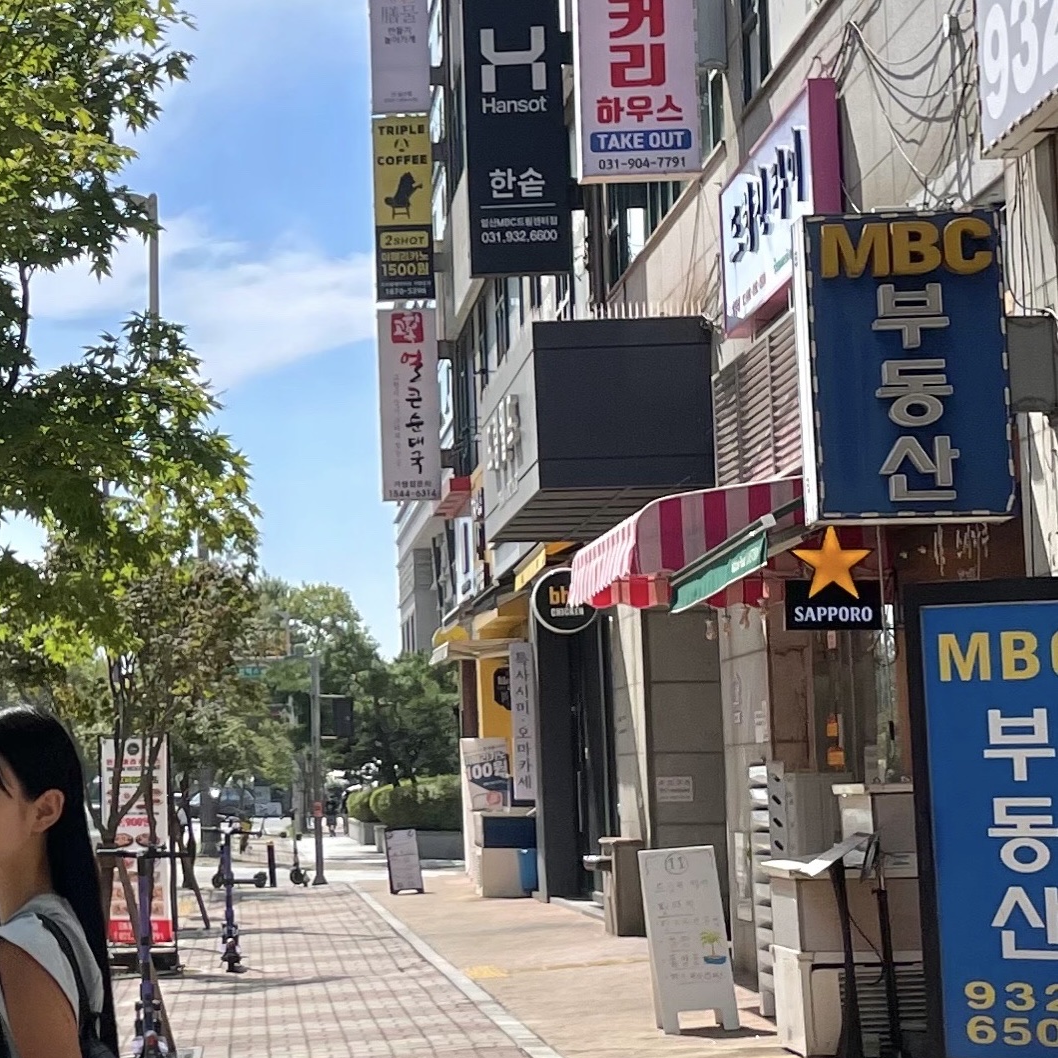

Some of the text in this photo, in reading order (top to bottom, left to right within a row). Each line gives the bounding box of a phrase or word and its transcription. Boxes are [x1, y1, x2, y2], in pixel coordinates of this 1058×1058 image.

[607, 0, 667, 88] 커리
[482, 95, 547, 114] Hansot
[596, 94, 684, 124] 하우스
[378, 124, 425, 136] TRIPLE
[597, 130, 685, 150] TAKE OUT
[377, 154, 428, 166] COFFEE
[598, 156, 686, 170] 031-904-7791
[489, 166, 546, 199] 한솥
[820, 217, 994, 279] MBC
[380, 262, 430, 277] 1500원
[871, 283, 961, 502] 부동산
[794, 605, 873, 623] SAPPORO
[938, 631, 1058, 682] MB
[983, 708, 1058, 960] 부동산
